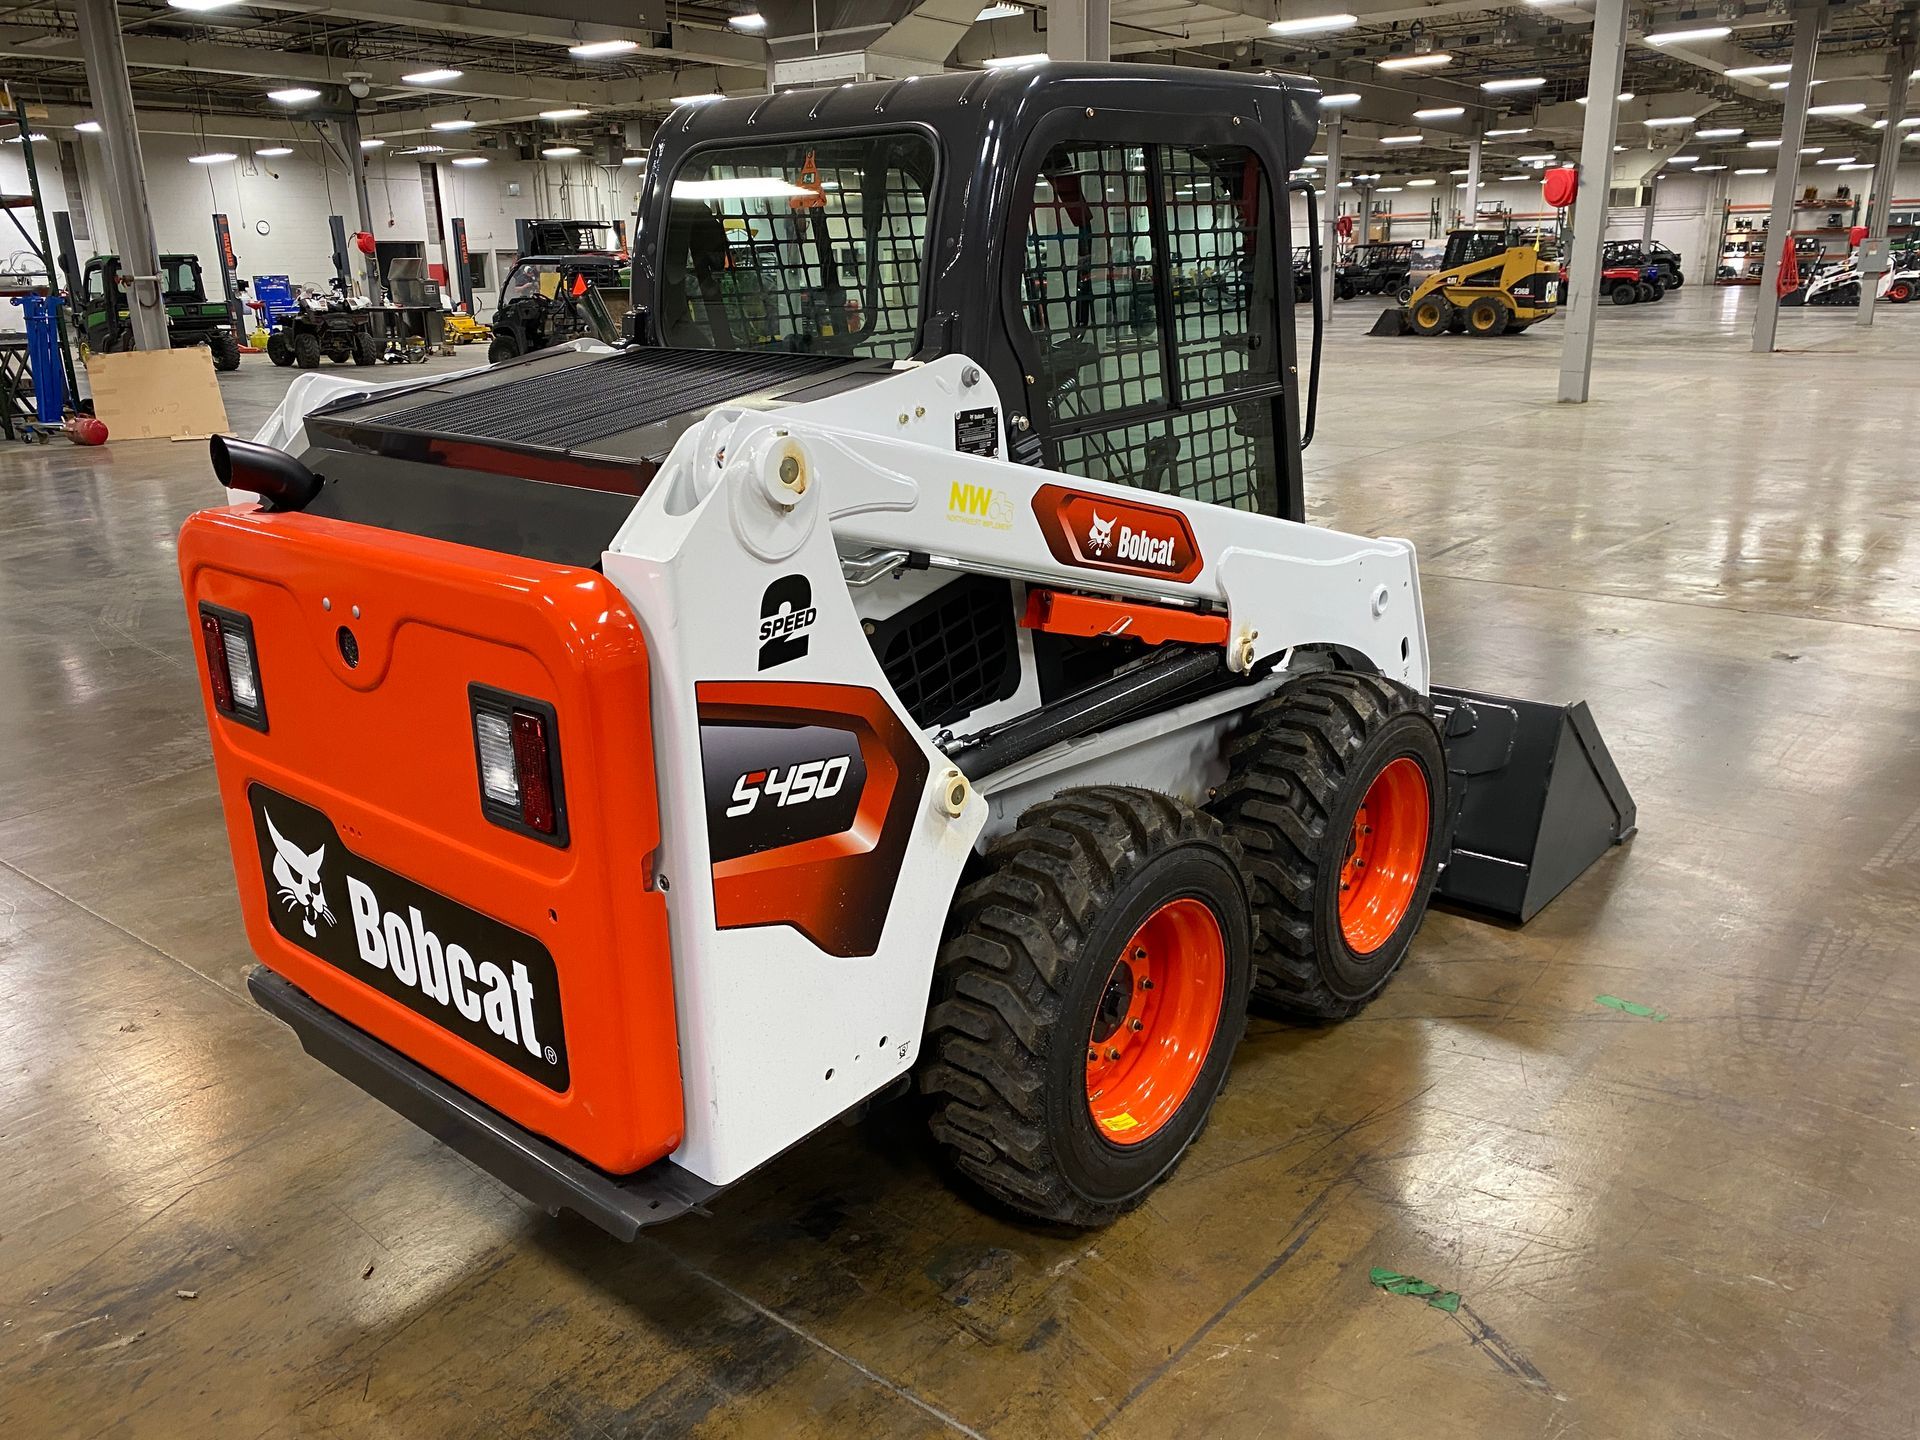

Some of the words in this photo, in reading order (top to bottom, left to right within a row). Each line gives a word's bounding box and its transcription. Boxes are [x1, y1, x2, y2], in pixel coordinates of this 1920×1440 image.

[223, 232, 235, 267] STRATUS
[460, 233, 469, 264] STRATUS
[1513, 287, 1530, 295] 236B
[1545, 281, 1559, 303] CAT
[949, 480, 993, 517] NW
[1117, 526, 1175, 567] Bobcat
[758, 607, 817, 641] SPEED
[725, 756, 851, 818] S450
[347, 874, 542, 1059] Bobcat
